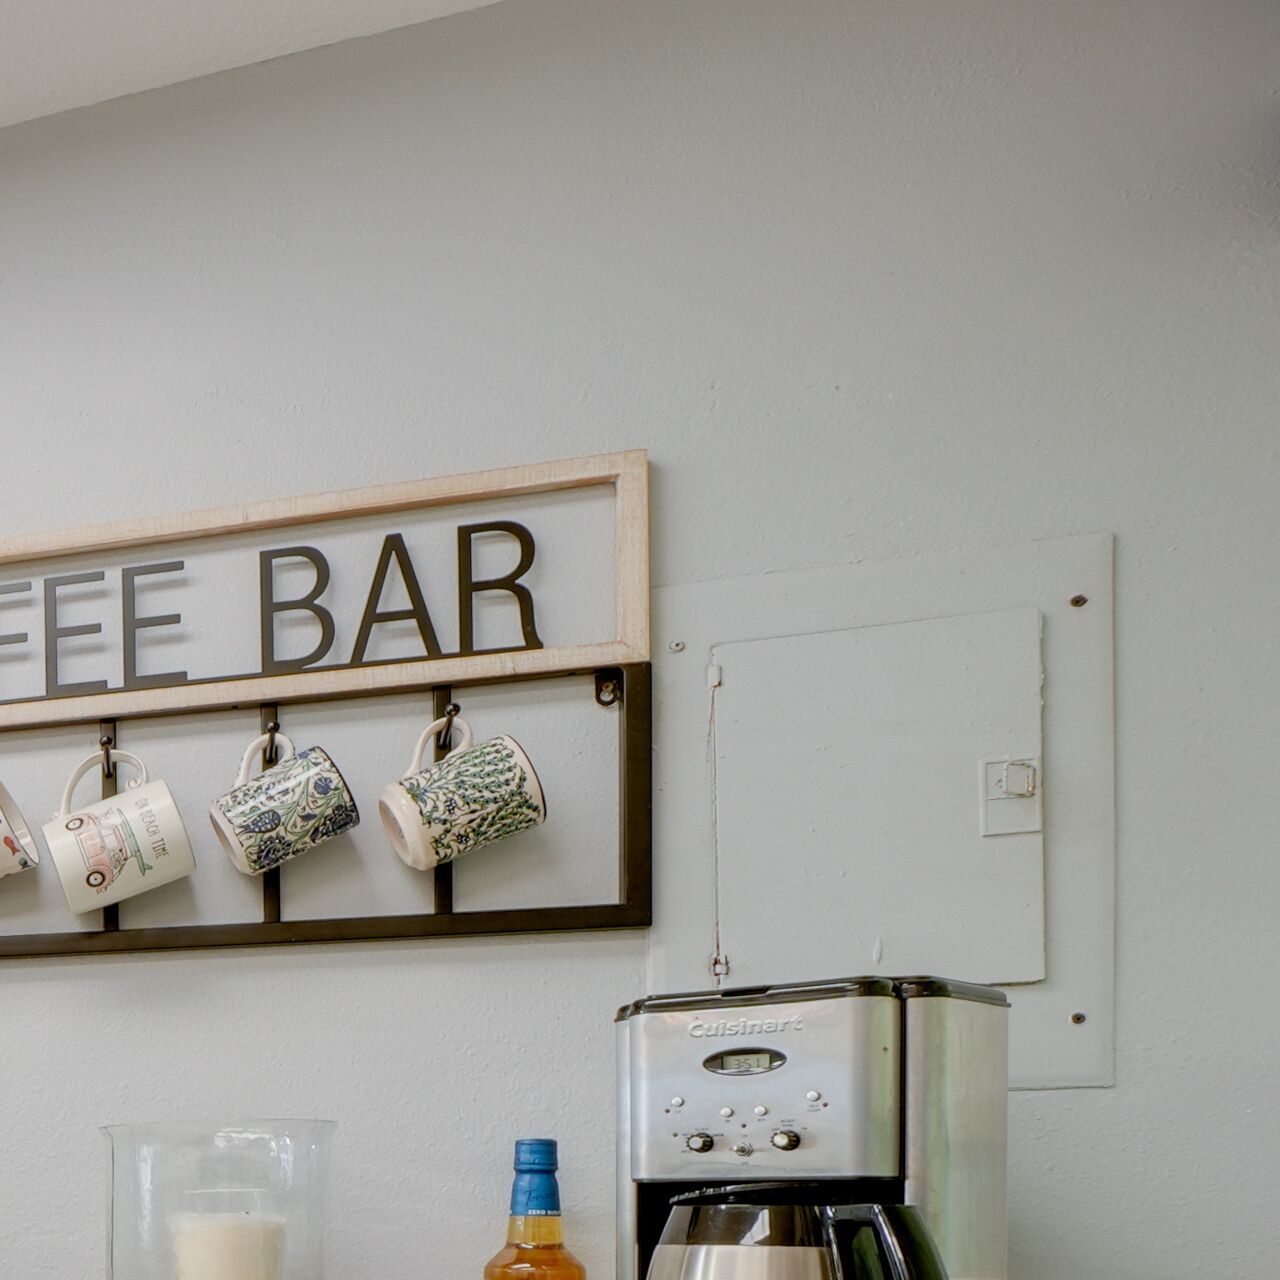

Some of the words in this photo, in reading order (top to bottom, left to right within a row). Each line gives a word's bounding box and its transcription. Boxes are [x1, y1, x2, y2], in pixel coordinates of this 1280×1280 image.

[259, 519, 543, 675] BAR
[139, 809, 161, 837] BEACH
[151, 837, 169, 860] TIME
[689, 1014, 804, 1038] Cuisinart
